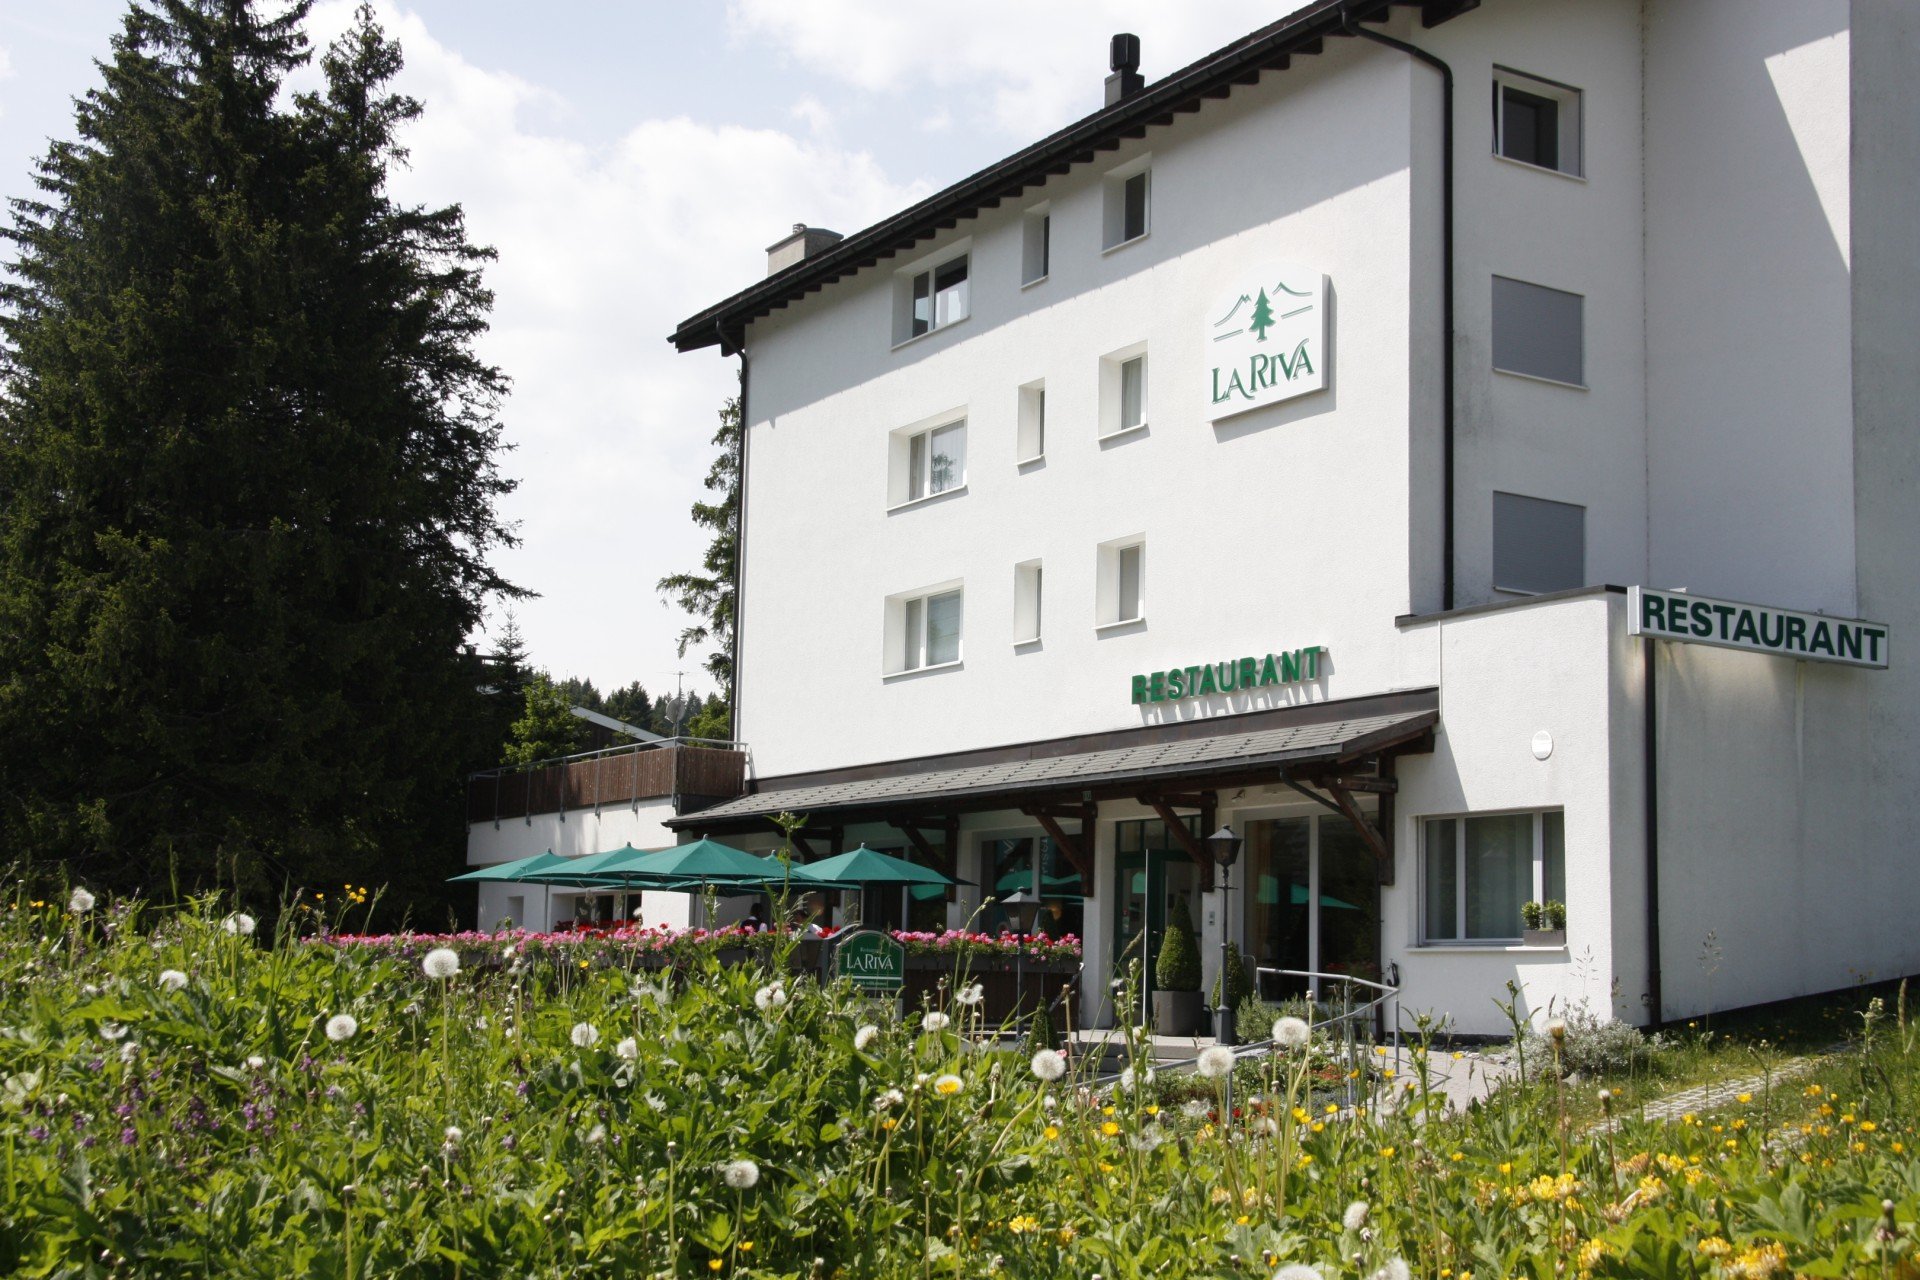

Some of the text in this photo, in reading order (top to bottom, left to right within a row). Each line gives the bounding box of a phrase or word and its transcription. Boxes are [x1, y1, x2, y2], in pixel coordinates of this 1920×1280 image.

[1211, 338, 1315, 404] LA RIVA
[1642, 593, 1885, 661] RESTAURANT
[1131, 645, 1323, 705] RESTAURANT
[846, 953, 894, 972] LA RIVA
